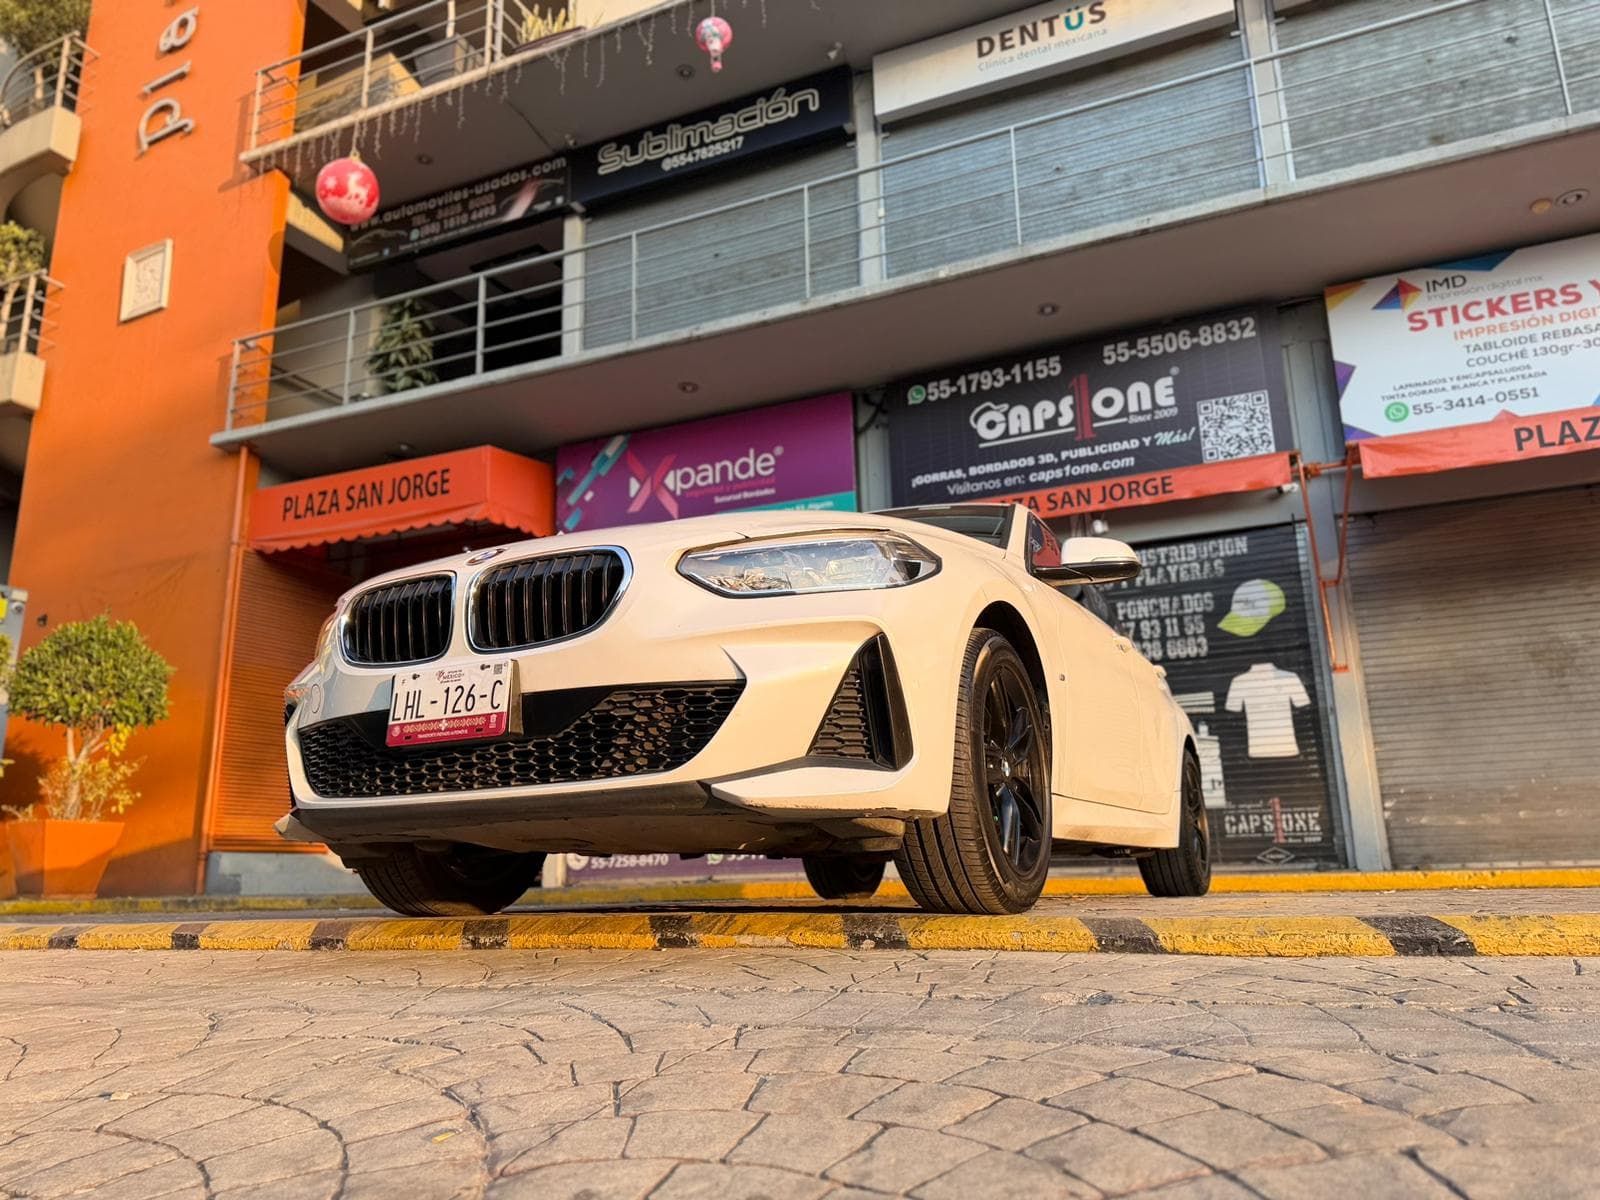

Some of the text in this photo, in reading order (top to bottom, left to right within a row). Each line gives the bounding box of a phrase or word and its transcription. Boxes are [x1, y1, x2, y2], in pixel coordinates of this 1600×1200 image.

[1016, 43, 1052, 61] dental
[1053, 28, 1108, 48] mexicana
[137, 0, 201, 153] Pla
[597, 87, 820, 175] Sublimación
[1425, 275, 1467, 293] IMD
[1407, 283, 1583, 332] STICKERS
[1453, 305, 1600, 341] IMPRESIÓN DIGI
[926, 316, 1257, 402] 55-1793-1155 55-5506-8832
[1464, 333, 1538, 354] TABLOIDE
[1412, 386, 1540, 415] 55-3414-0551
[968, 456, 1035, 476] BORDADOS
[1037, 452, 1058, 465] 3D,
[1061, 438, 1140, 461] PUBLICIDAD
[1142, 436, 1152, 447] Y
[1153, 426, 1196, 446] Más!
[1513, 415, 1600, 452] PLAZ
[281, 467, 451, 522] PLAZA SAN JORGE
[1003, 474, 1026, 487] en:
[1046, 488, 1091, 511] SAN
[1096, 475, 1174, 504] JORGE
[391, 680, 503, 722] LHL-126-C
